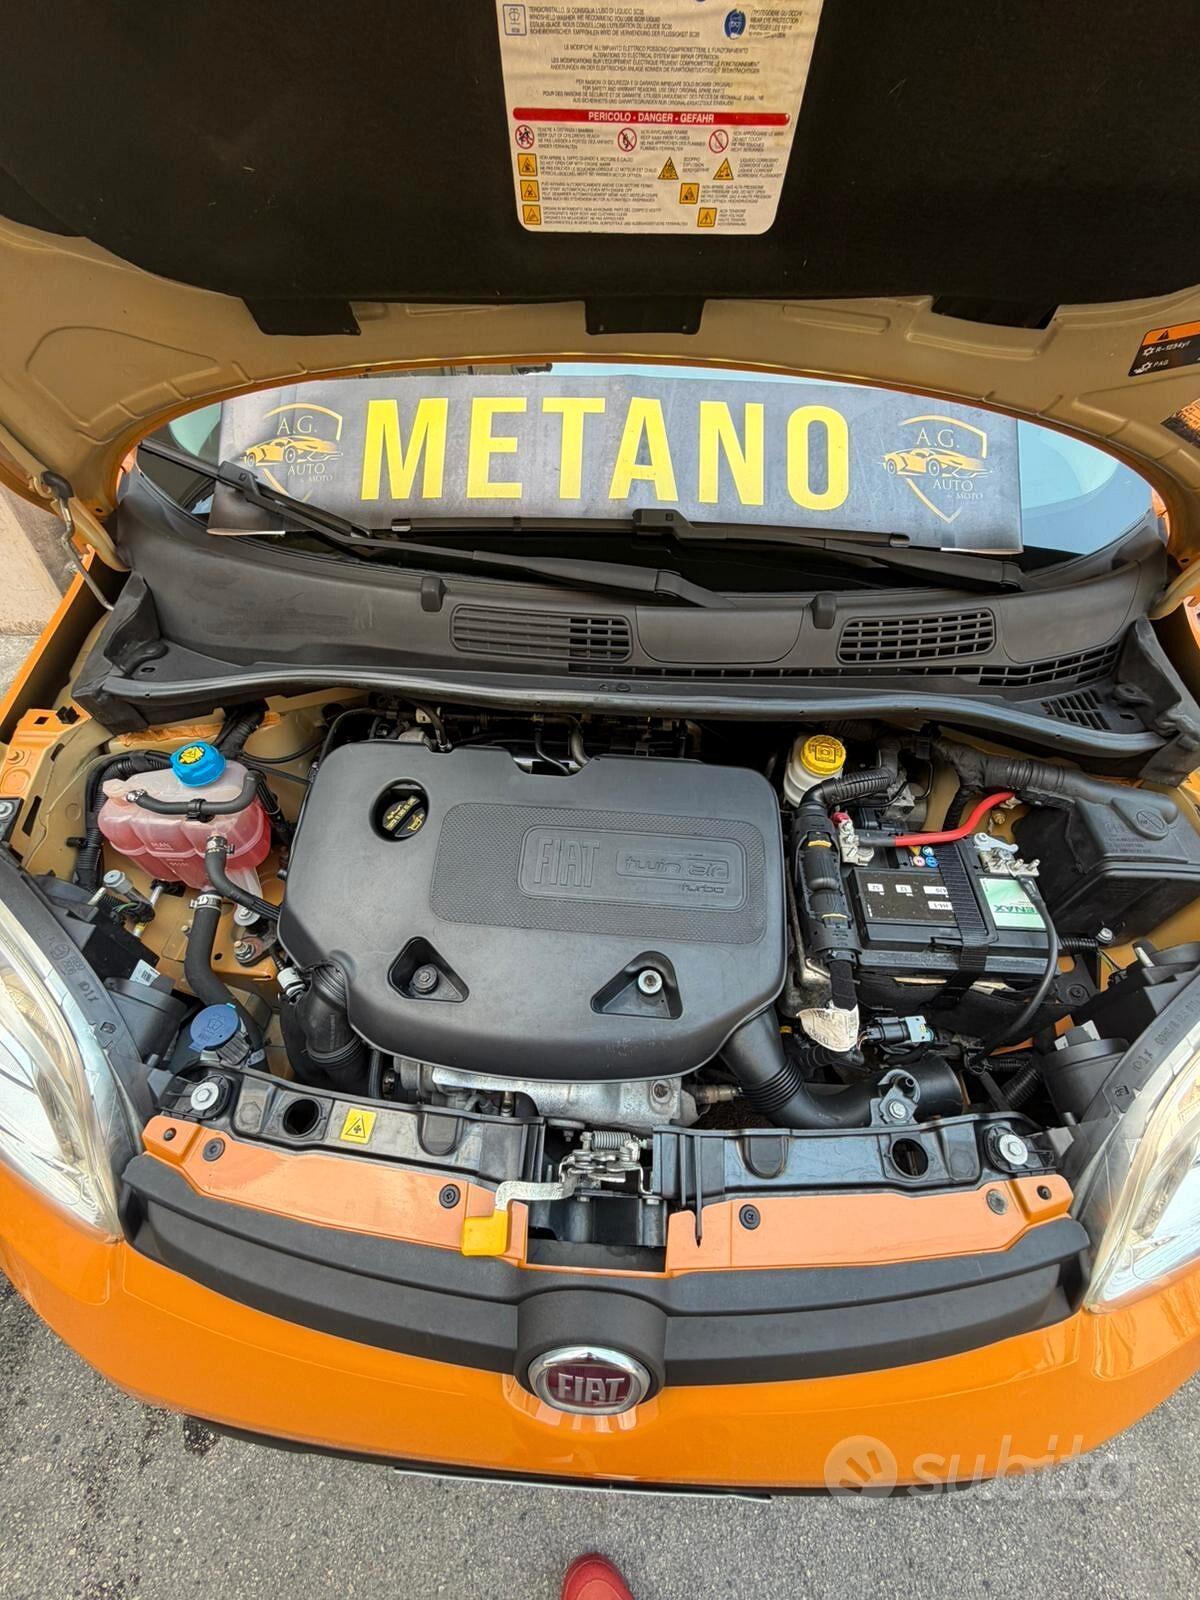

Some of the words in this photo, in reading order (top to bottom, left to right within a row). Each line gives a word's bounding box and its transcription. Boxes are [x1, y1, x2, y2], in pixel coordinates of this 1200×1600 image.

[588, 112, 631, 122] PERICOLO
[638, 113, 673, 122] DANGER
[680, 114, 715, 124] GEFAHR
[276, 414, 318, 435] A.G.
[916, 428, 960, 448] A.G.
[361, 397, 849, 511] METANO
[288, 463, 325, 476] AUTO
[933, 480, 974, 492] AUTO
[534, 838, 600, 888] FIAT
[681, 882, 725, 894] turbo
[558, 1372, 625, 1402] FIAT
